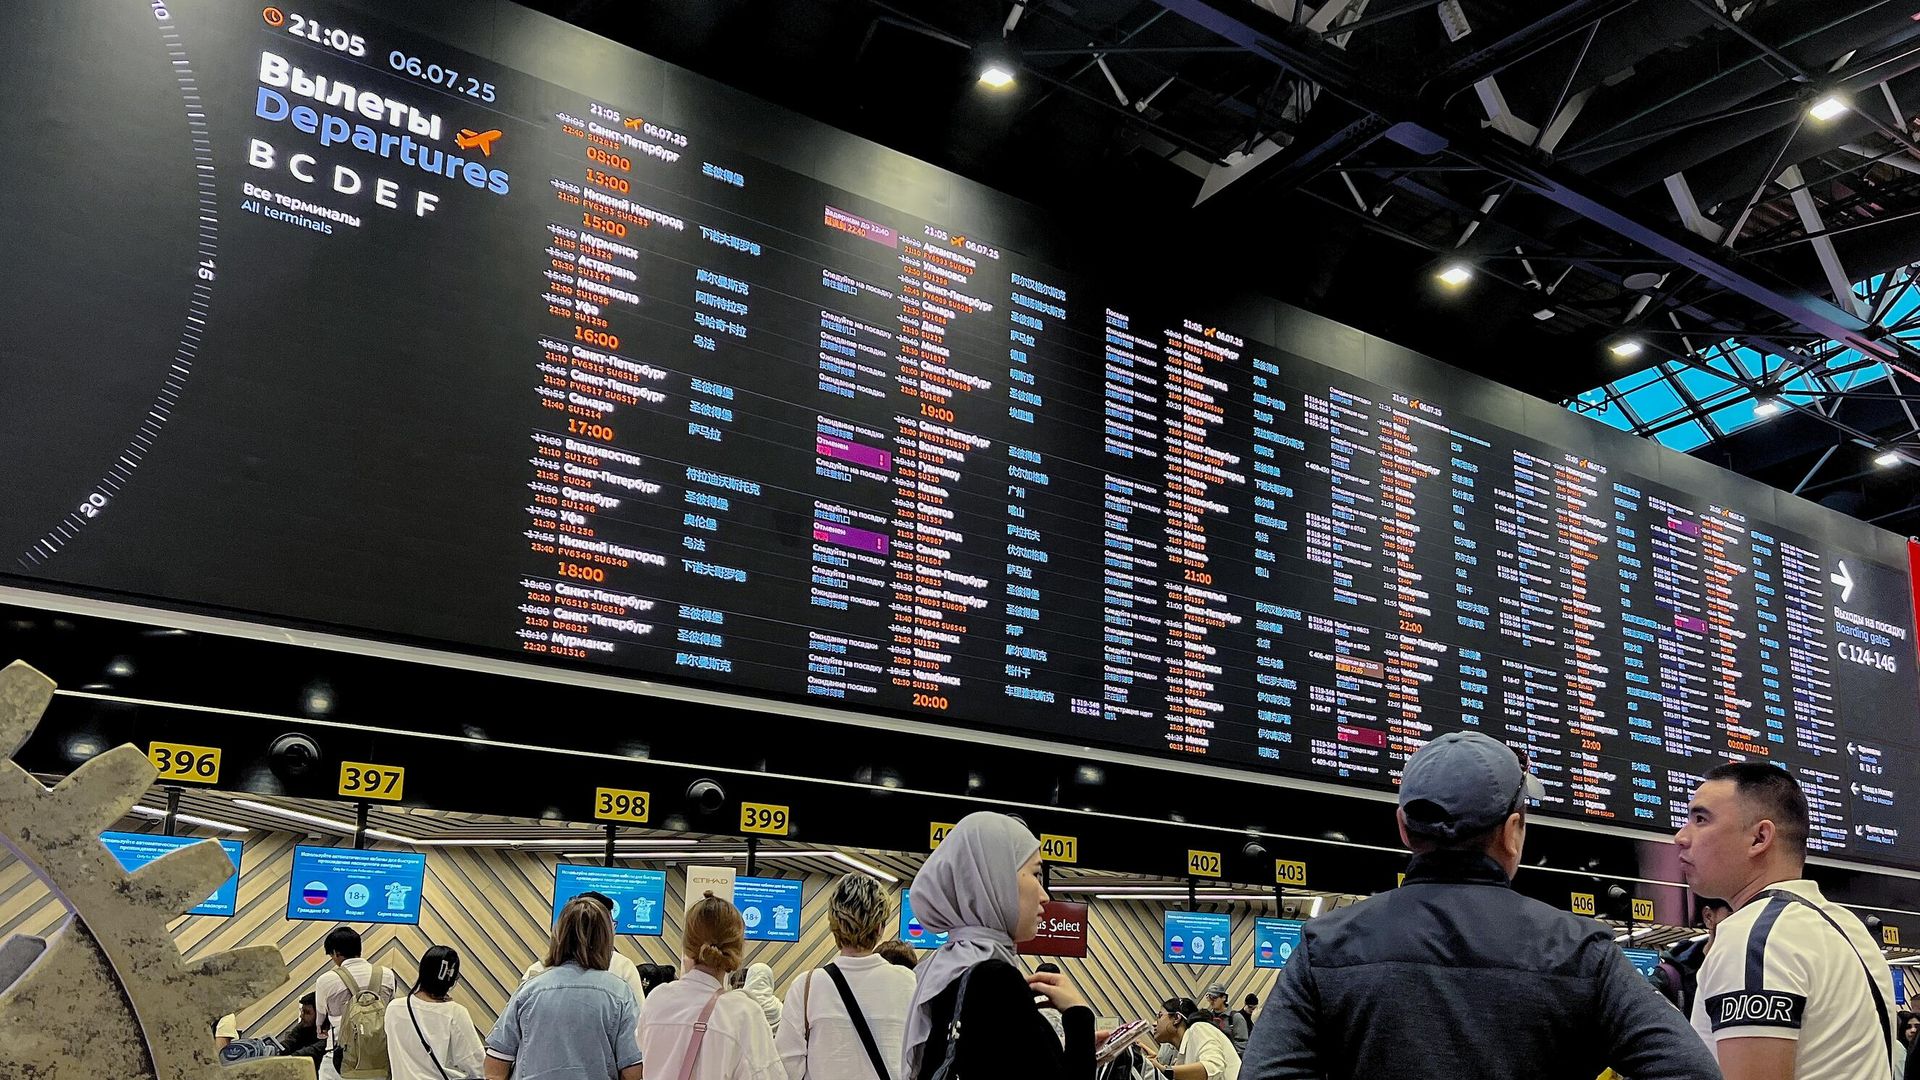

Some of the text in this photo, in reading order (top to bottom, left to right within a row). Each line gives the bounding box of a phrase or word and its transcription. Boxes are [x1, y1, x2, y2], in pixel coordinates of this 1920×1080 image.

[288, 13, 496, 104] 21:05 06.07.25
[258, 50, 442, 142] Вылеты
[590, 103, 621, 122] 21:05
[644, 123, 688, 148] 06.07.25
[254, 85, 512, 196] Departures
[588, 121, 681, 163] Санкт-Петербург
[586, 146, 631, 172] 08:00
[248, 138, 440, 218] B C D E F
[586, 168, 630, 193] 13:00
[242, 182, 362, 228] Все терминалы
[584, 187, 685, 231] Нижний Новгород
[241, 199, 334, 236] All terminals
[582, 212, 628, 238] 15:00
[580, 232, 639, 260] Мурманск
[924, 225, 1000, 260] 21:05 06.07.25
[198, 258, 215, 281] 15
[578, 255, 638, 282] Астрахань
[550, 282, 573, 294] 22:00
[576, 278, 640, 306] Махачкала
[575, 299, 600, 316] Уфа
[694, 312, 747, 338] 马哈奇卡拉
[574, 324, 619, 350] 16:00
[692, 334, 716, 351] 乌法
[544, 351, 568, 364] 21:10
[572, 345, 668, 380] Санкт-Петербург
[543, 374, 566, 388] 21:20
[570, 369, 666, 404] Санкт-Петербург
[691, 378, 734, 400] 圣彼得堡
[542, 398, 602, 419] 21:40 SU1214
[568, 392, 614, 413] Самара
[690, 400, 732, 422] 圣彼得堡
[920, 402, 954, 424] 19:00
[568, 418, 614, 442] 17:00
[688, 422, 722, 442] 萨马拉
[538, 446, 561, 459] 21:10
[566, 439, 640, 466] Владивосток
[563, 476, 592, 489] SU024
[564, 463, 661, 495] Санкт-Петербург
[686, 467, 761, 495] 符拉迪沃斯托克
[534, 494, 558, 506] 21:30
[562, 486, 620, 508] Оренбург
[918, 482, 949, 498] Казань
[80, 492, 106, 518] 20
[684, 490, 730, 512] 圣彼得堡
[916, 502, 954, 520] Саратов
[533, 518, 556, 530] 21:30
[560, 511, 585, 526] Уфа
[684, 513, 717, 532] 奥伦堡
[813, 522, 846, 536] Отменен
[532, 542, 554, 554] 23:40
[558, 534, 608, 554] Нижний
[610, 542, 666, 568] Новгород
[682, 536, 706, 552] 乌法
[916, 544, 951, 560] Самара
[558, 561, 604, 582] 18:00
[682, 558, 747, 582] 下诺夫哥罗德
[1184, 569, 1212, 585] 21:00
[528, 592, 625, 616] 20:20 FV6519 SU6519
[555, 582, 654, 610] Санкт-Петербург
[914, 584, 988, 610] Санкт-Петербург
[553, 607, 653, 634] Санкт-Петербург
[678, 605, 724, 624] 圣彼得堡
[914, 604, 942, 620] Пенза
[526, 616, 588, 634] 21:30 DP6823
[1400, 620, 1422, 634] 22:00
[1834, 606, 1906, 640] Выходы на посадку
[551, 632, 614, 653] Мурманск
[677, 628, 722, 648] 圣彼得堡
[914, 626, 960, 644] Мурманск
[1836, 622, 1890, 647] Boarding gates
[524, 642, 586, 658] 22:20 SU1316
[914, 648, 952, 664] Ташкент
[1838, 642, 1896, 673] C 124-146
[676, 652, 732, 673] 摩尔曼斯克
[808, 654, 882, 674] Следуйте на посадку
[912, 670, 961, 687] Челябинск
[912, 693, 948, 710] 20:00
[1581, 739, 1601, 751] 23:00
[1727, 740, 1744, 751] 00:00
[154, 748, 216, 777] 396
[343, 768, 400, 794] 397
[598, 793, 646, 816] 398
[744, 808, 786, 830] 399
[1042, 840, 1074, 858] 401
[1190, 854, 1219, 873] 402
[1278, 864, 1304, 880] 403
[348, 892, 366, 900] 18+
[1573, 896, 1594, 912] 406
[1634, 903, 1652, 917] 407
[1049, 918, 1080, 932] Select
[1883, 929, 1898, 942] 411
[1720, 994, 1793, 1023] DIOR
